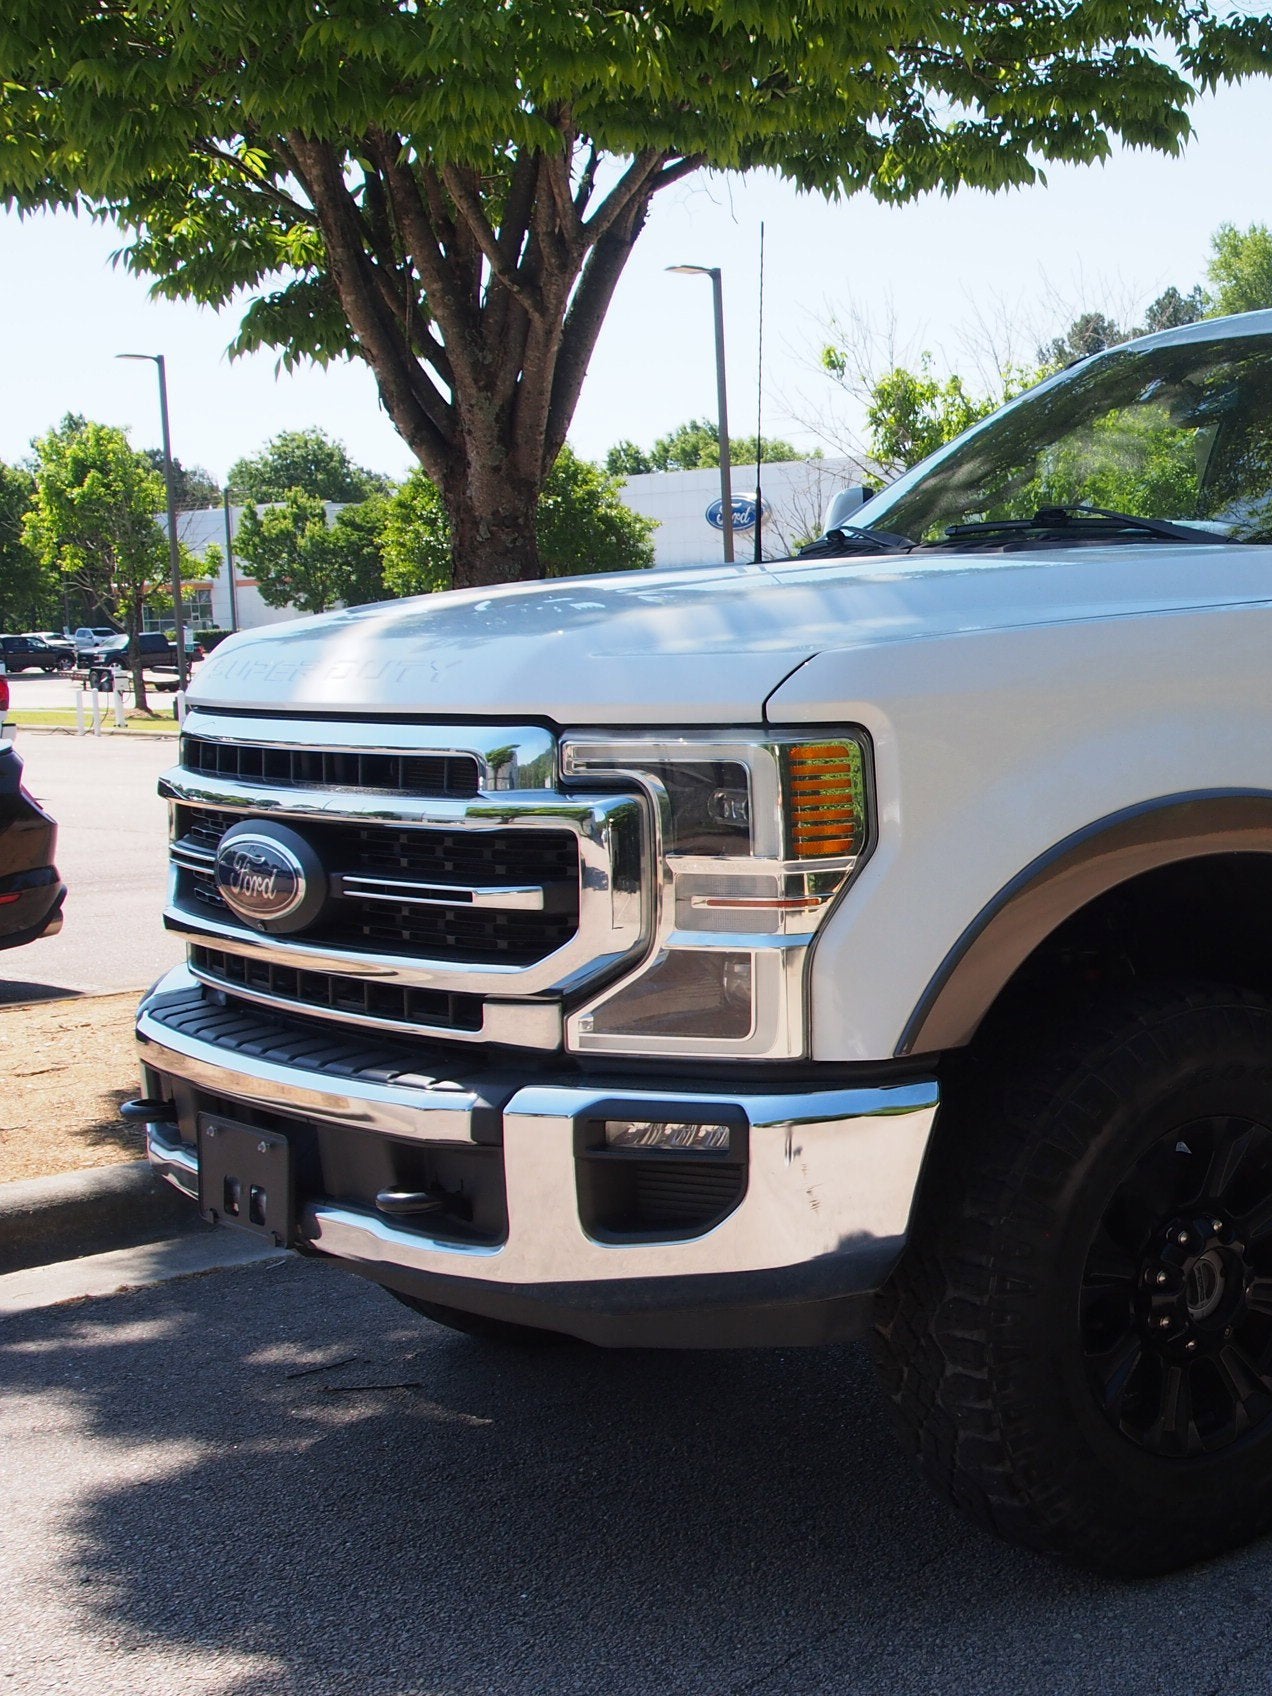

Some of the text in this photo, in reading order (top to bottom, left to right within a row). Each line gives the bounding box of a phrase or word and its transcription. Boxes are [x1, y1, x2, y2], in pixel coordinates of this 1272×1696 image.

[716, 502, 751, 525] Frd
[208, 659, 464, 683] SUPER DUTY
[230, 851, 277, 900] Ford
